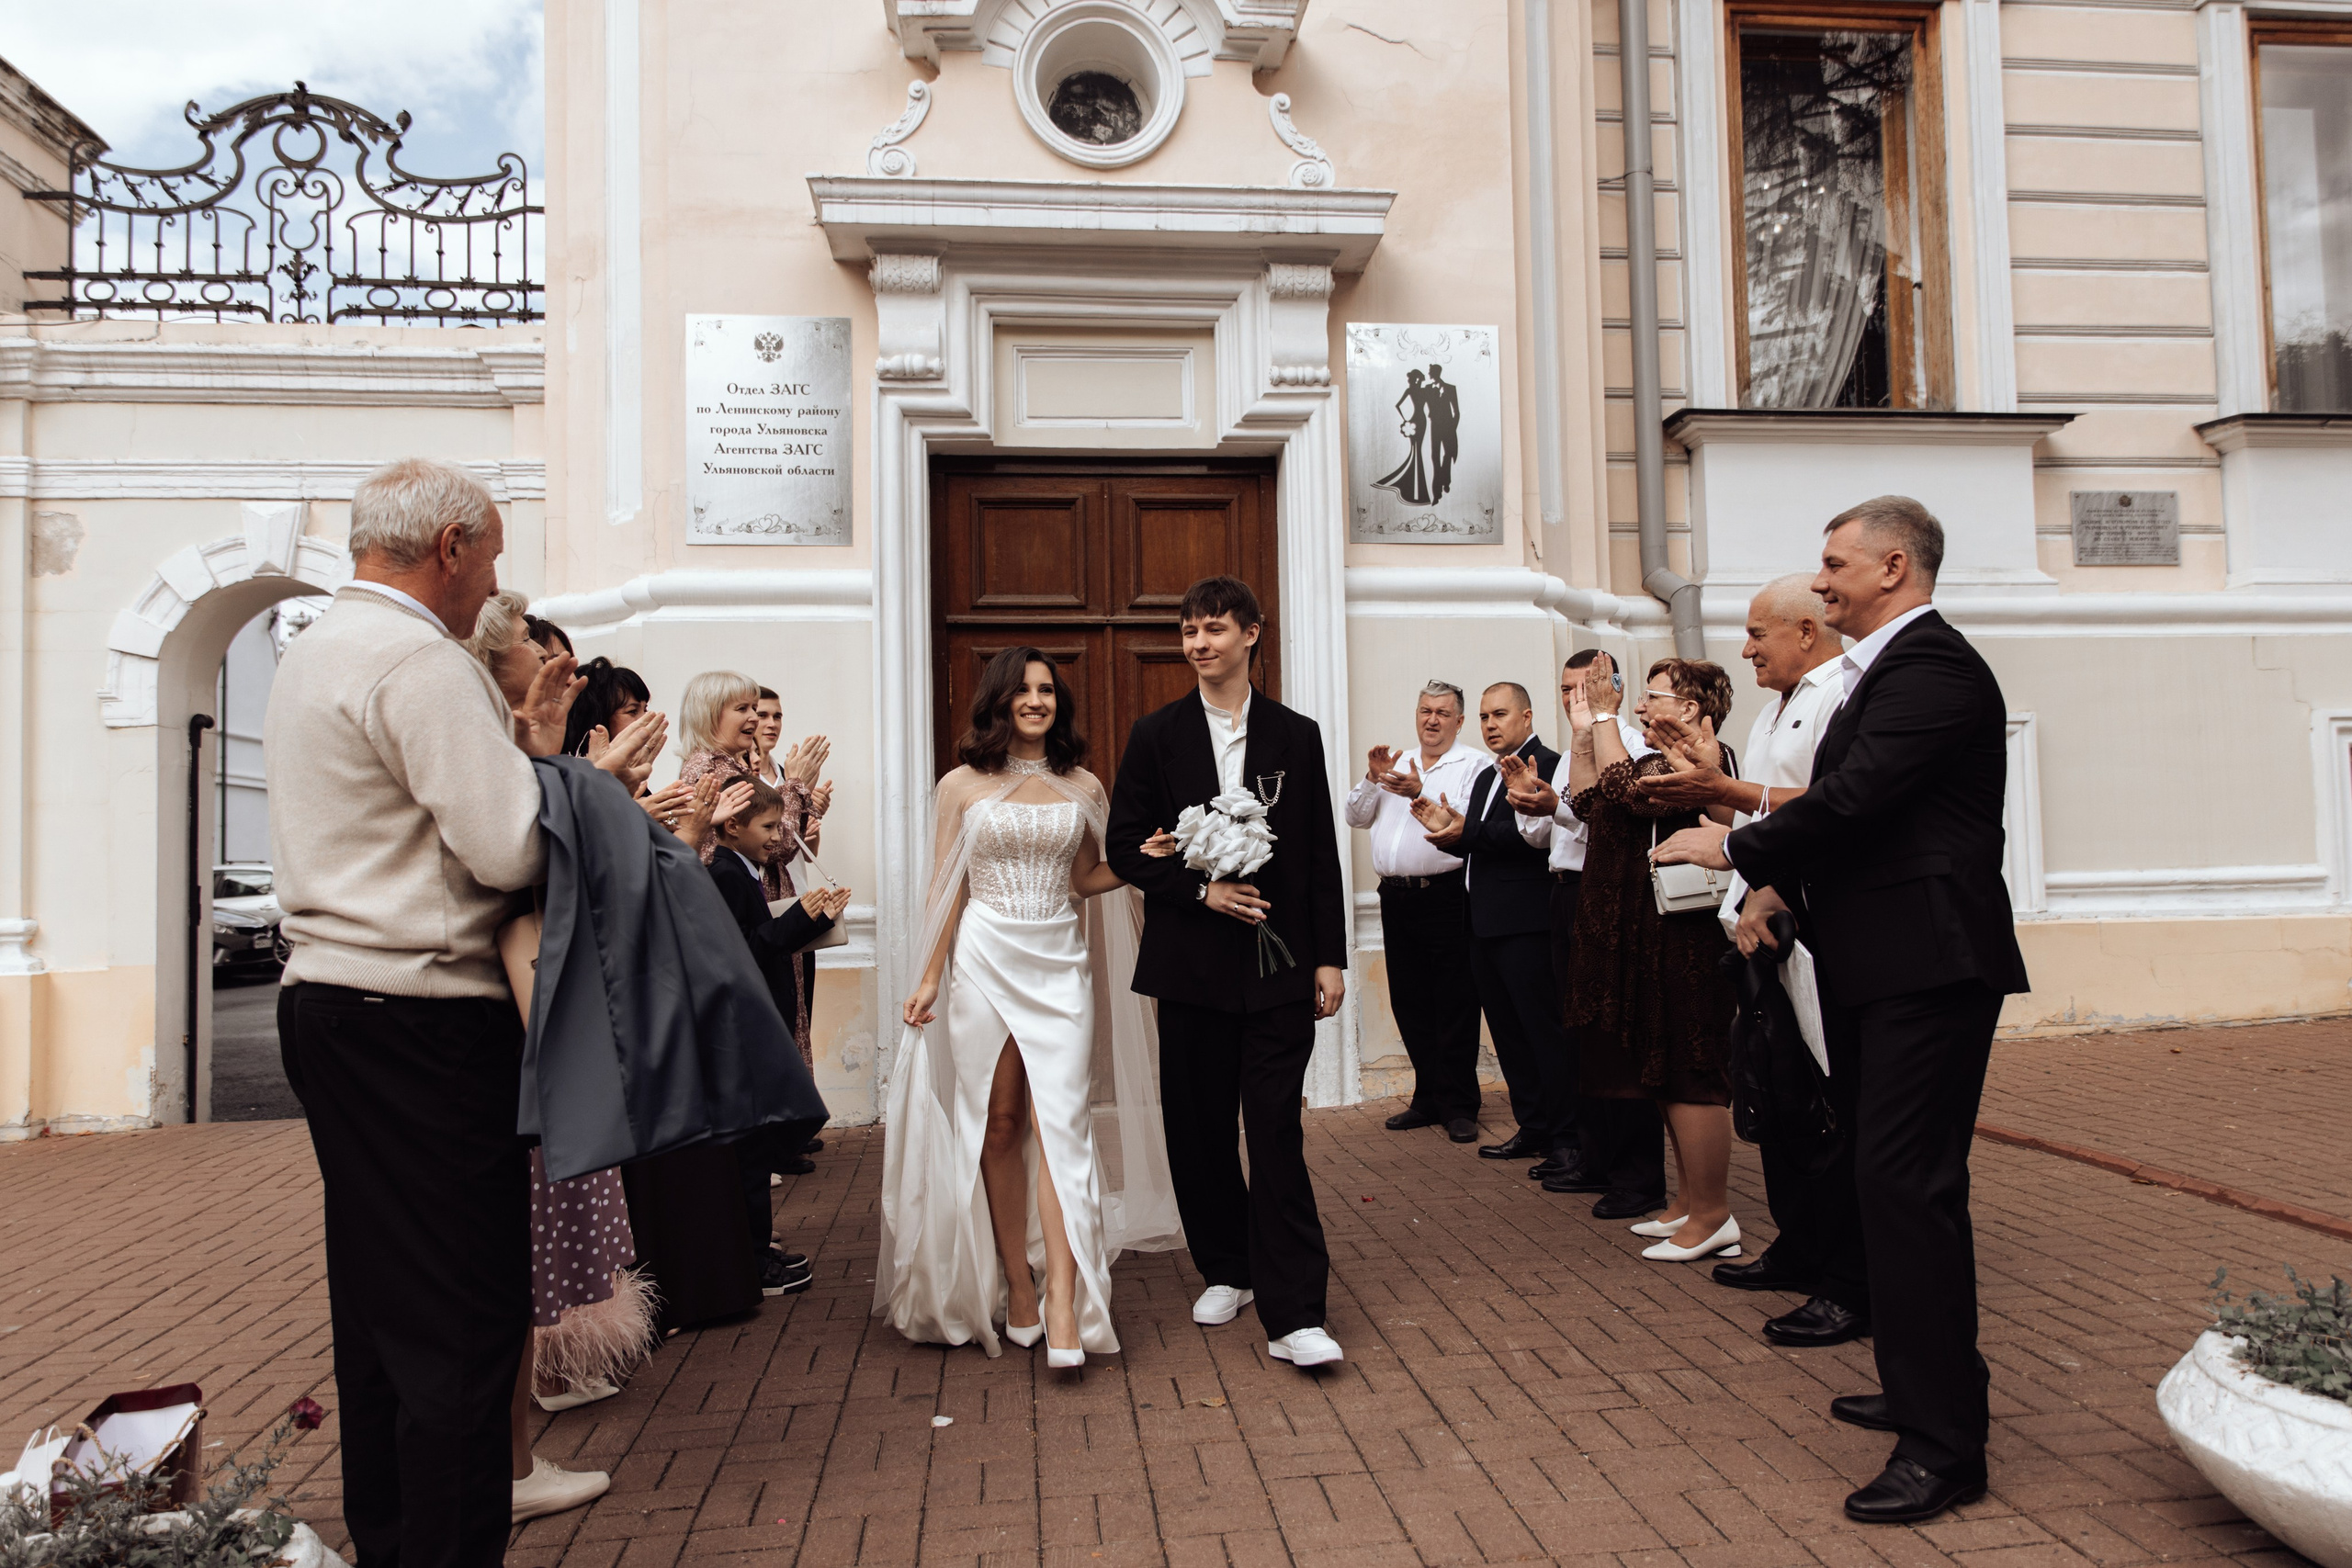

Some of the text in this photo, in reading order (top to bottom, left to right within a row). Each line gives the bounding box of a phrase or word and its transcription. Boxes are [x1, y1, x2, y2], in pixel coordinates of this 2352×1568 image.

[726, 382, 811, 396] Отдел ЗАГС
[696, 401, 842, 419] по Ленинскому району
[709, 423, 828, 437] города Ульяновска
[713, 442, 824, 457] Агентства ЗАГС
[703, 462, 835, 476] Ульяновской области
